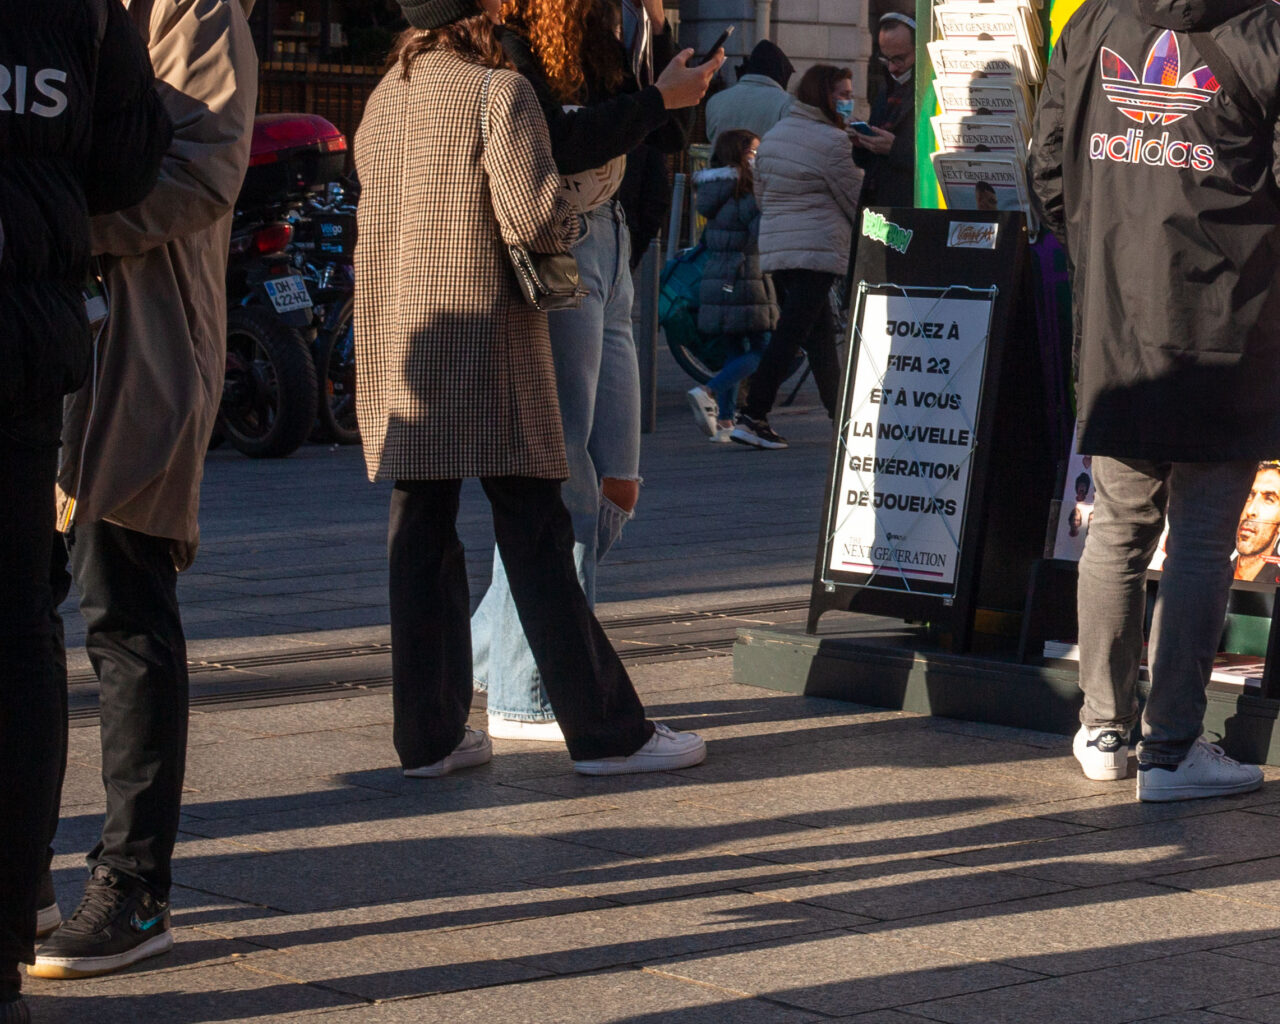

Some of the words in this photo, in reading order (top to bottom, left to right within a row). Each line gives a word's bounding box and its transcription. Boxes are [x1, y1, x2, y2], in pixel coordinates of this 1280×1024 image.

[1090, 128, 1214, 171] adidas
[886, 320, 945, 339] JOUEZ
[947, 320, 960, 340] À
[888, 354, 922, 373] FIFA
[926, 357, 950, 374] 22
[870, 388, 892, 404] ET
[895, 387, 907, 406] À
[912, 390, 962, 410] VOUS
[852, 421, 874, 438] LA
[877, 423, 970, 447] NOUVELLE
[846, 489, 869, 507] DE
[873, 492, 958, 516] JOUEURS
[843, 543, 873, 559] NEXT
[874, 546, 947, 567] GENERATION
